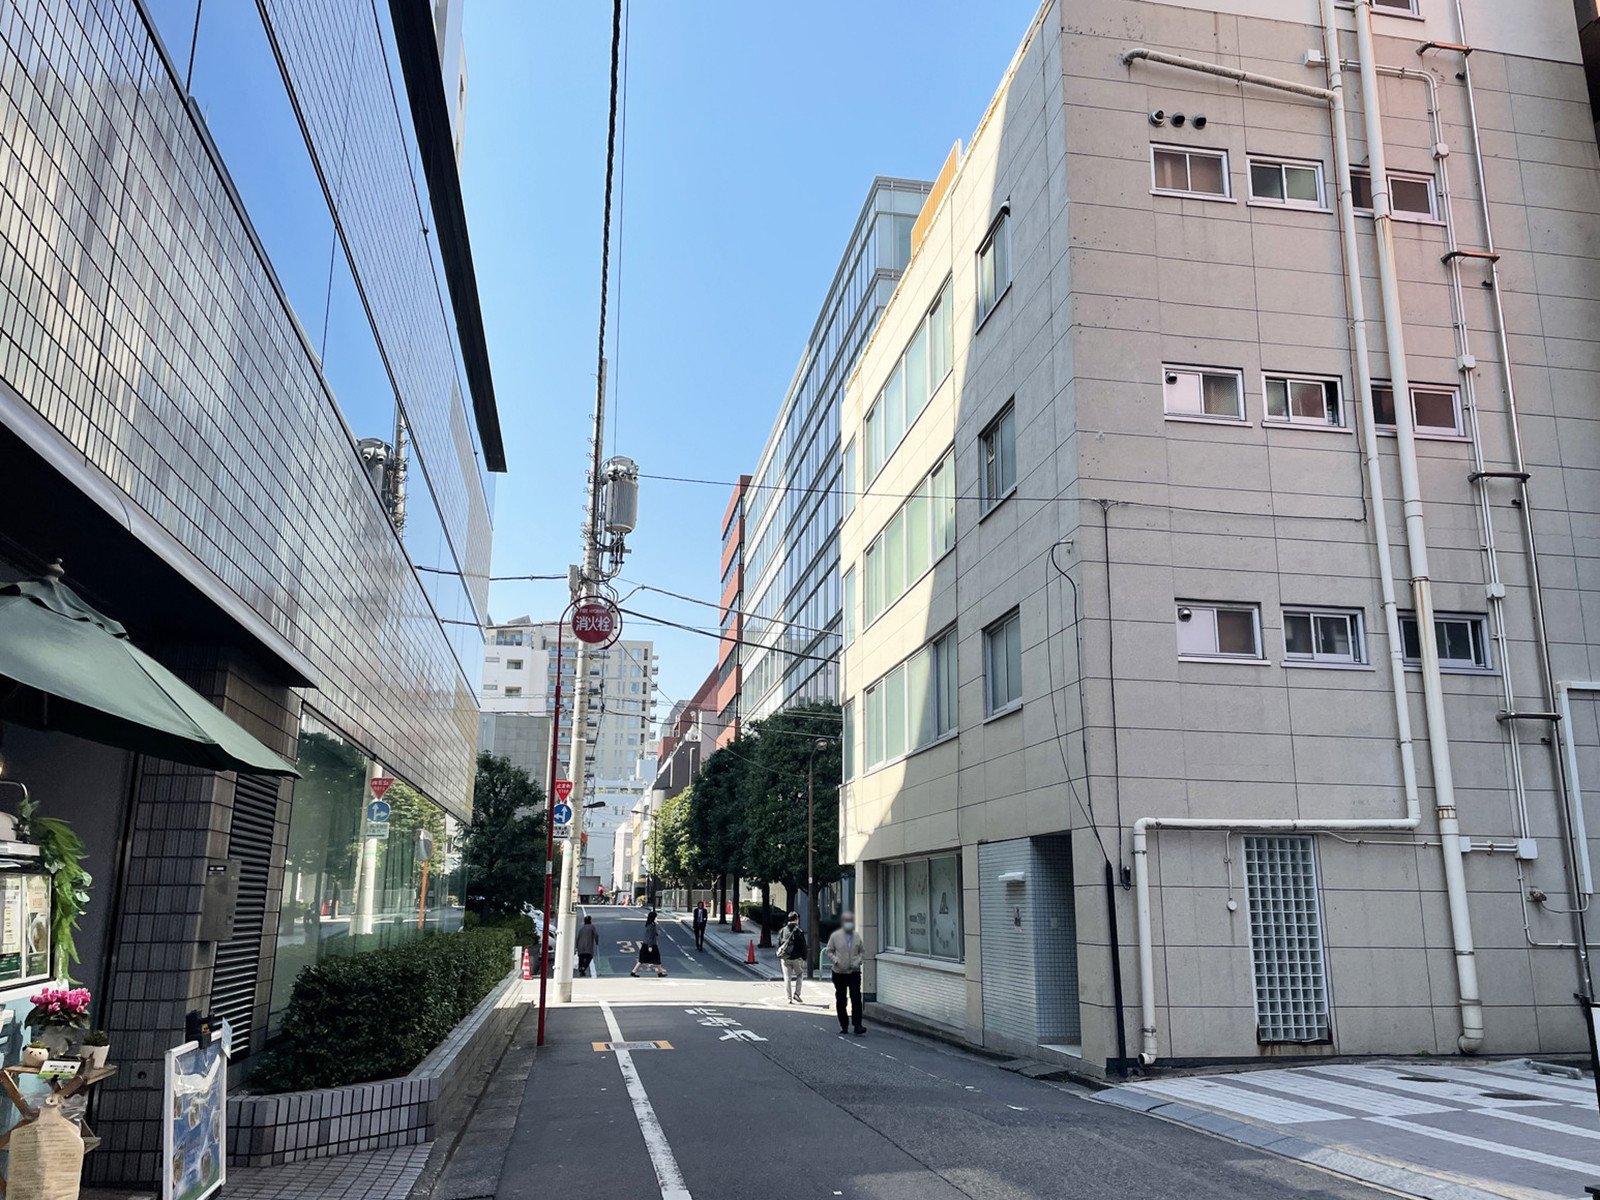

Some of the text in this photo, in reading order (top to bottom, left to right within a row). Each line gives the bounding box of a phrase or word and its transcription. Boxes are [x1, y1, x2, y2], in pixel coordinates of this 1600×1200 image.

[575, 615, 611, 632] 消火栓
[684, 1007, 769, 1042] 止まれ
